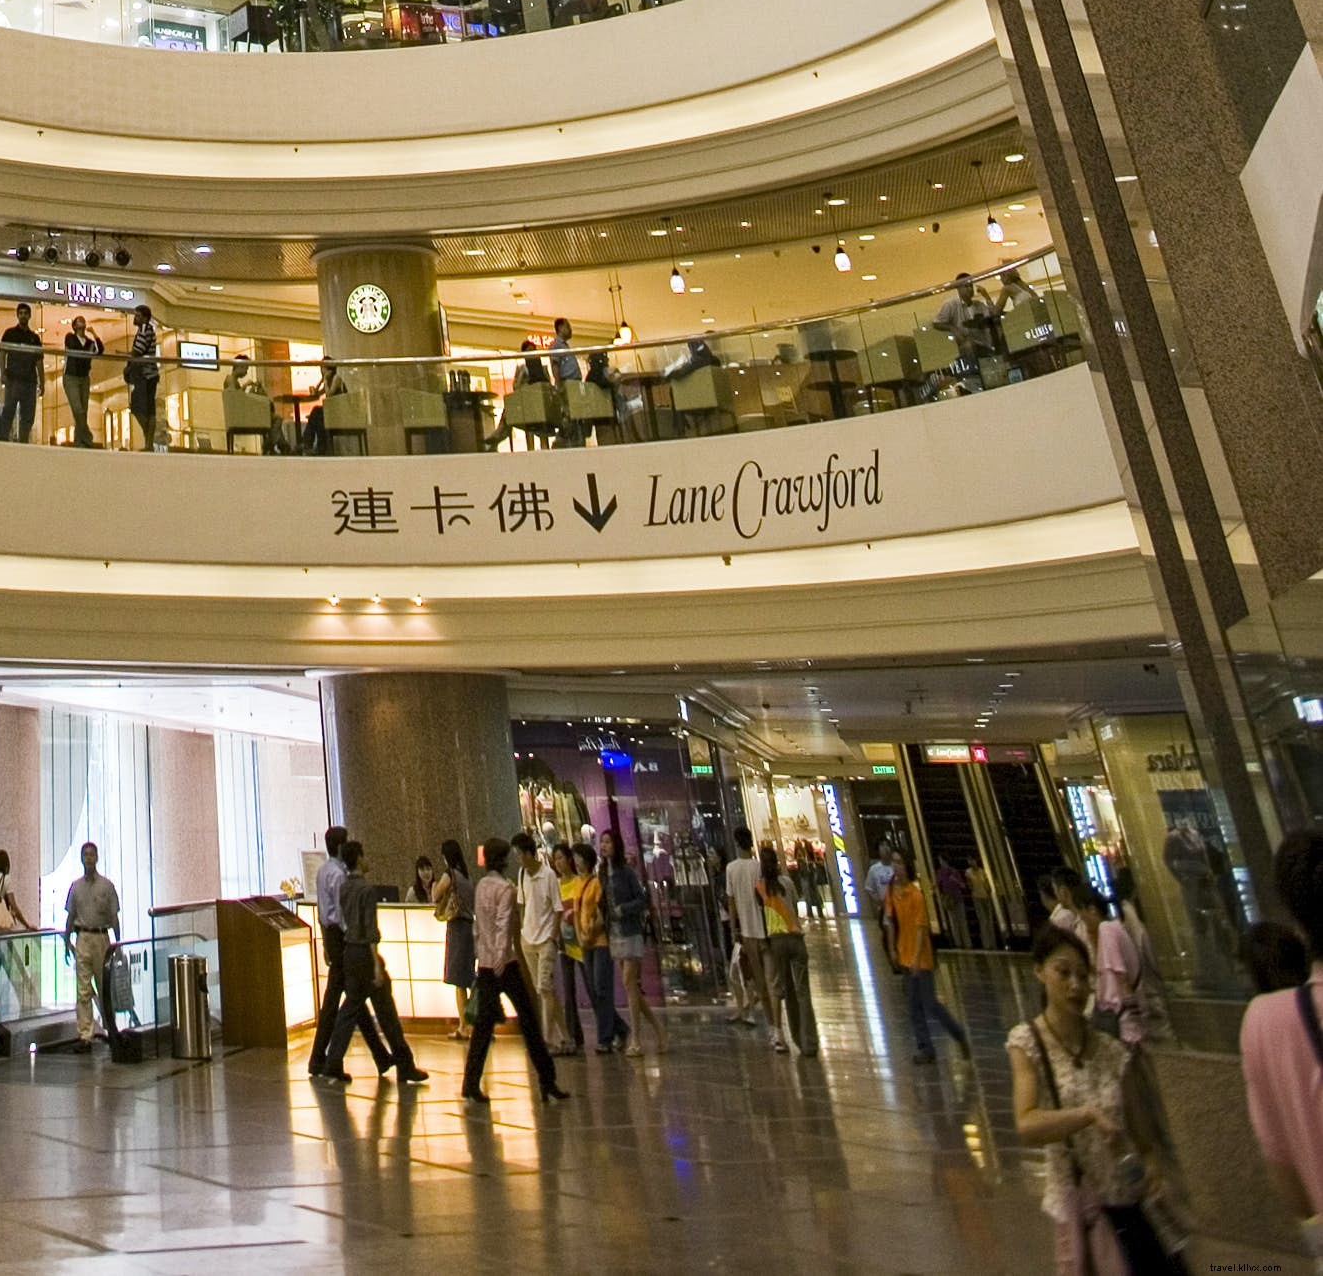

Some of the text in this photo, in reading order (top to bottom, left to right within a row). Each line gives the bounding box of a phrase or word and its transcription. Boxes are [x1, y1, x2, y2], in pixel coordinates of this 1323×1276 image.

[54, 280, 115, 300] LINKS
[330, 481, 556, 537] 連卡佛
[642, 448, 884, 540] Lane Crawford
